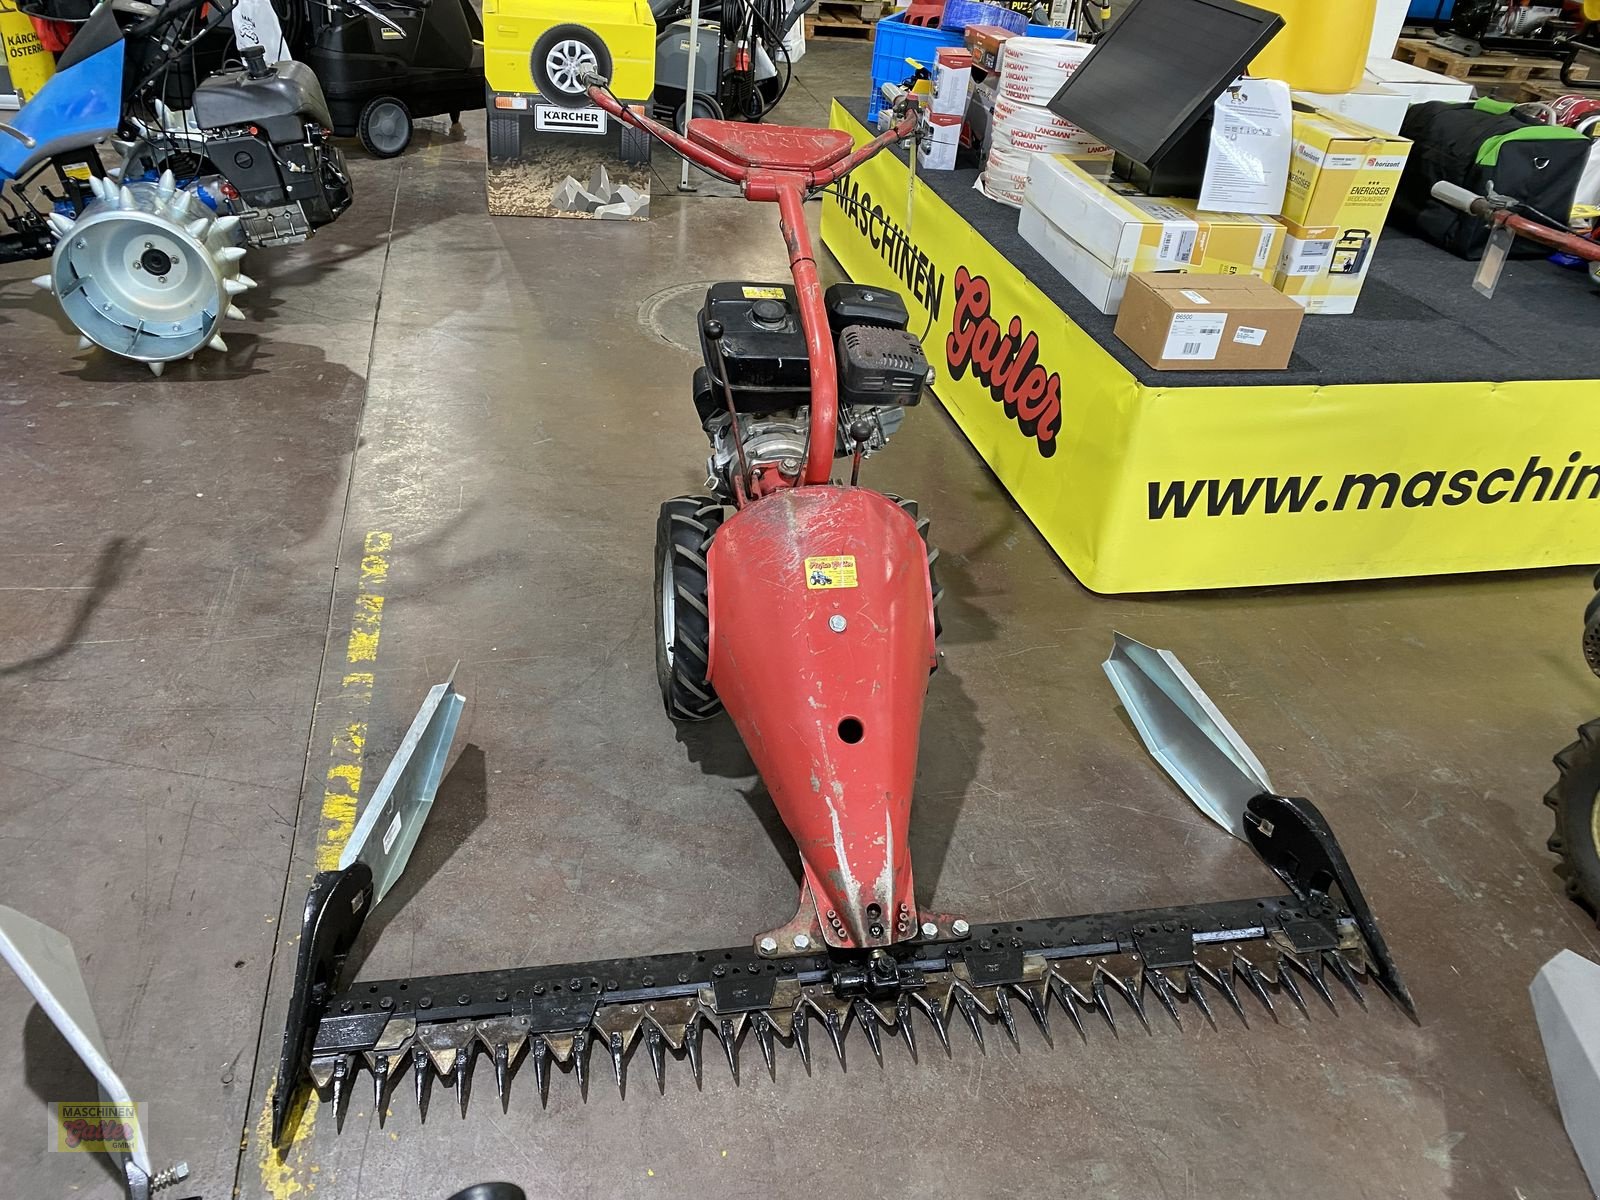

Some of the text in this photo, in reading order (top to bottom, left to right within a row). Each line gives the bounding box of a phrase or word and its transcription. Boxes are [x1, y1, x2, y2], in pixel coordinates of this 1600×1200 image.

[7, 32, 39, 46] KÄRCH
[10, 43, 43, 58] ÖSTERR
[544, 111, 598, 121] KÄRCHER
[1303, 148, 1320, 163] horizont
[1287, 172, 1311, 191] NERGISER
[1350, 186, 1390, 195] ENERGISER
[834, 173, 945, 322] MASCHINEN
[947, 265, 1062, 458] Gailer
